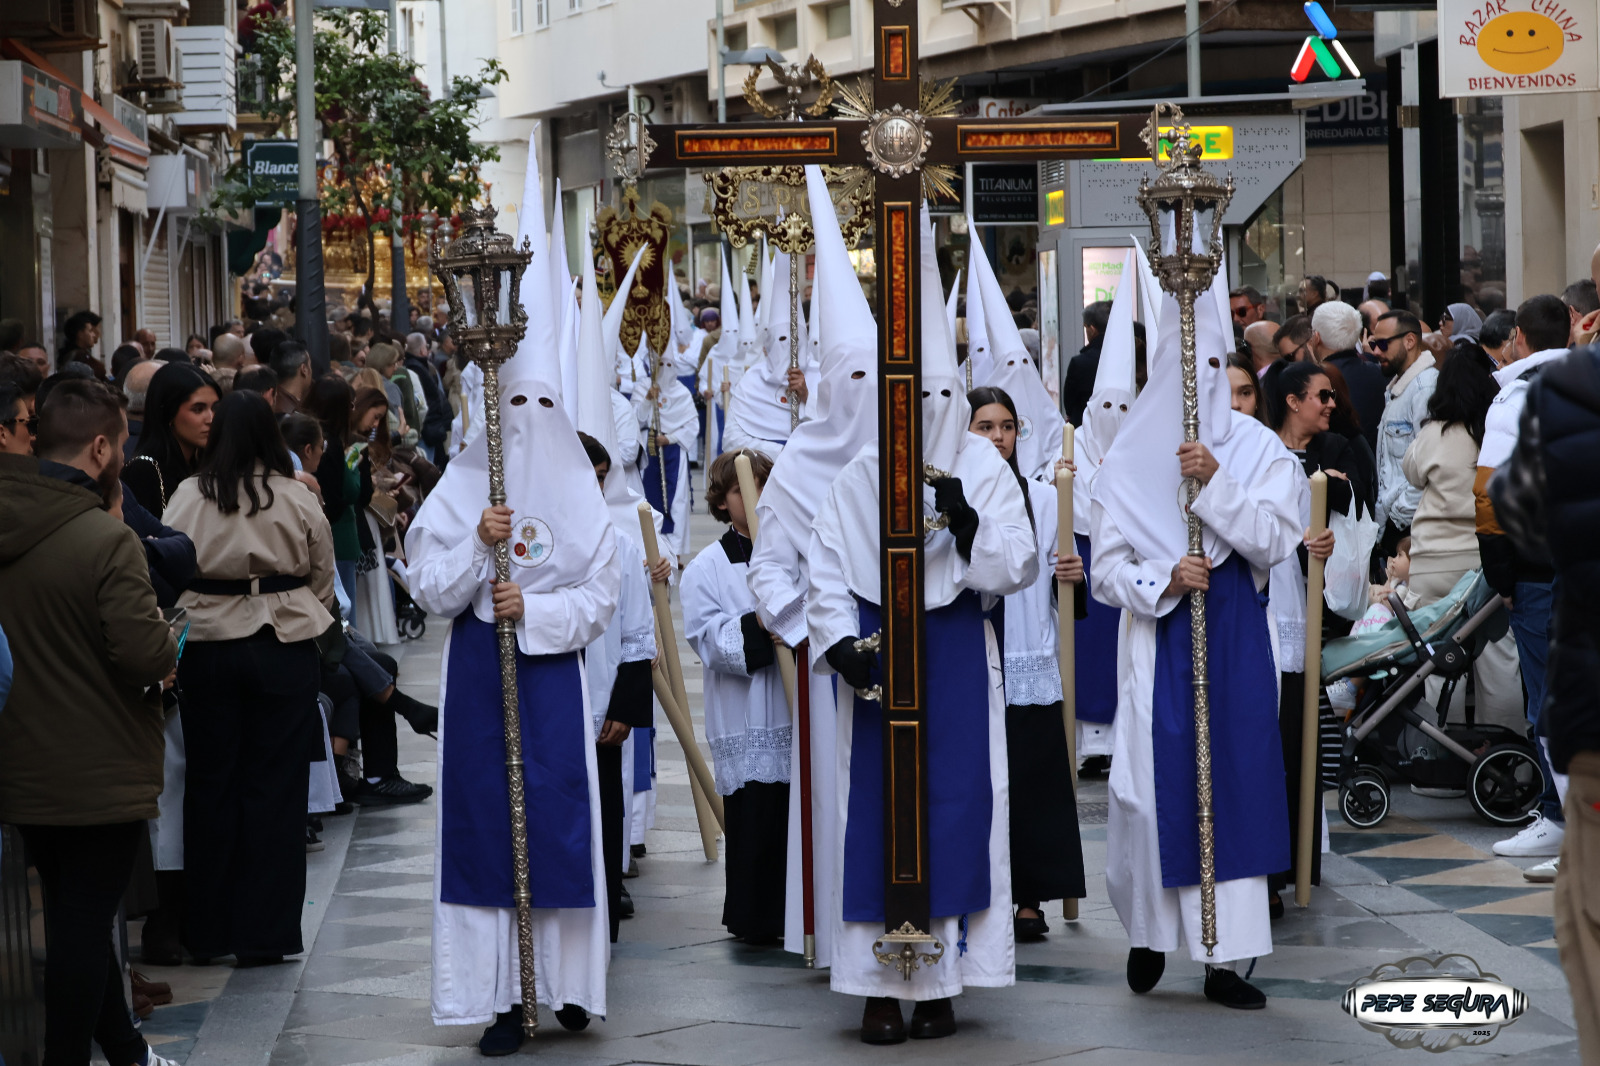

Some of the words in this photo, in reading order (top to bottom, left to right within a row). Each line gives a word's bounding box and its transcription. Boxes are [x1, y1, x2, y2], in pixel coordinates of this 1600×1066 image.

[1459, 0, 1509, 47] BAZAR
[1531, 0, 1583, 43] CHINA
[1468, 73, 1577, 91] BIENVENIDOS
[979, 177, 1033, 191] TITANIUM
